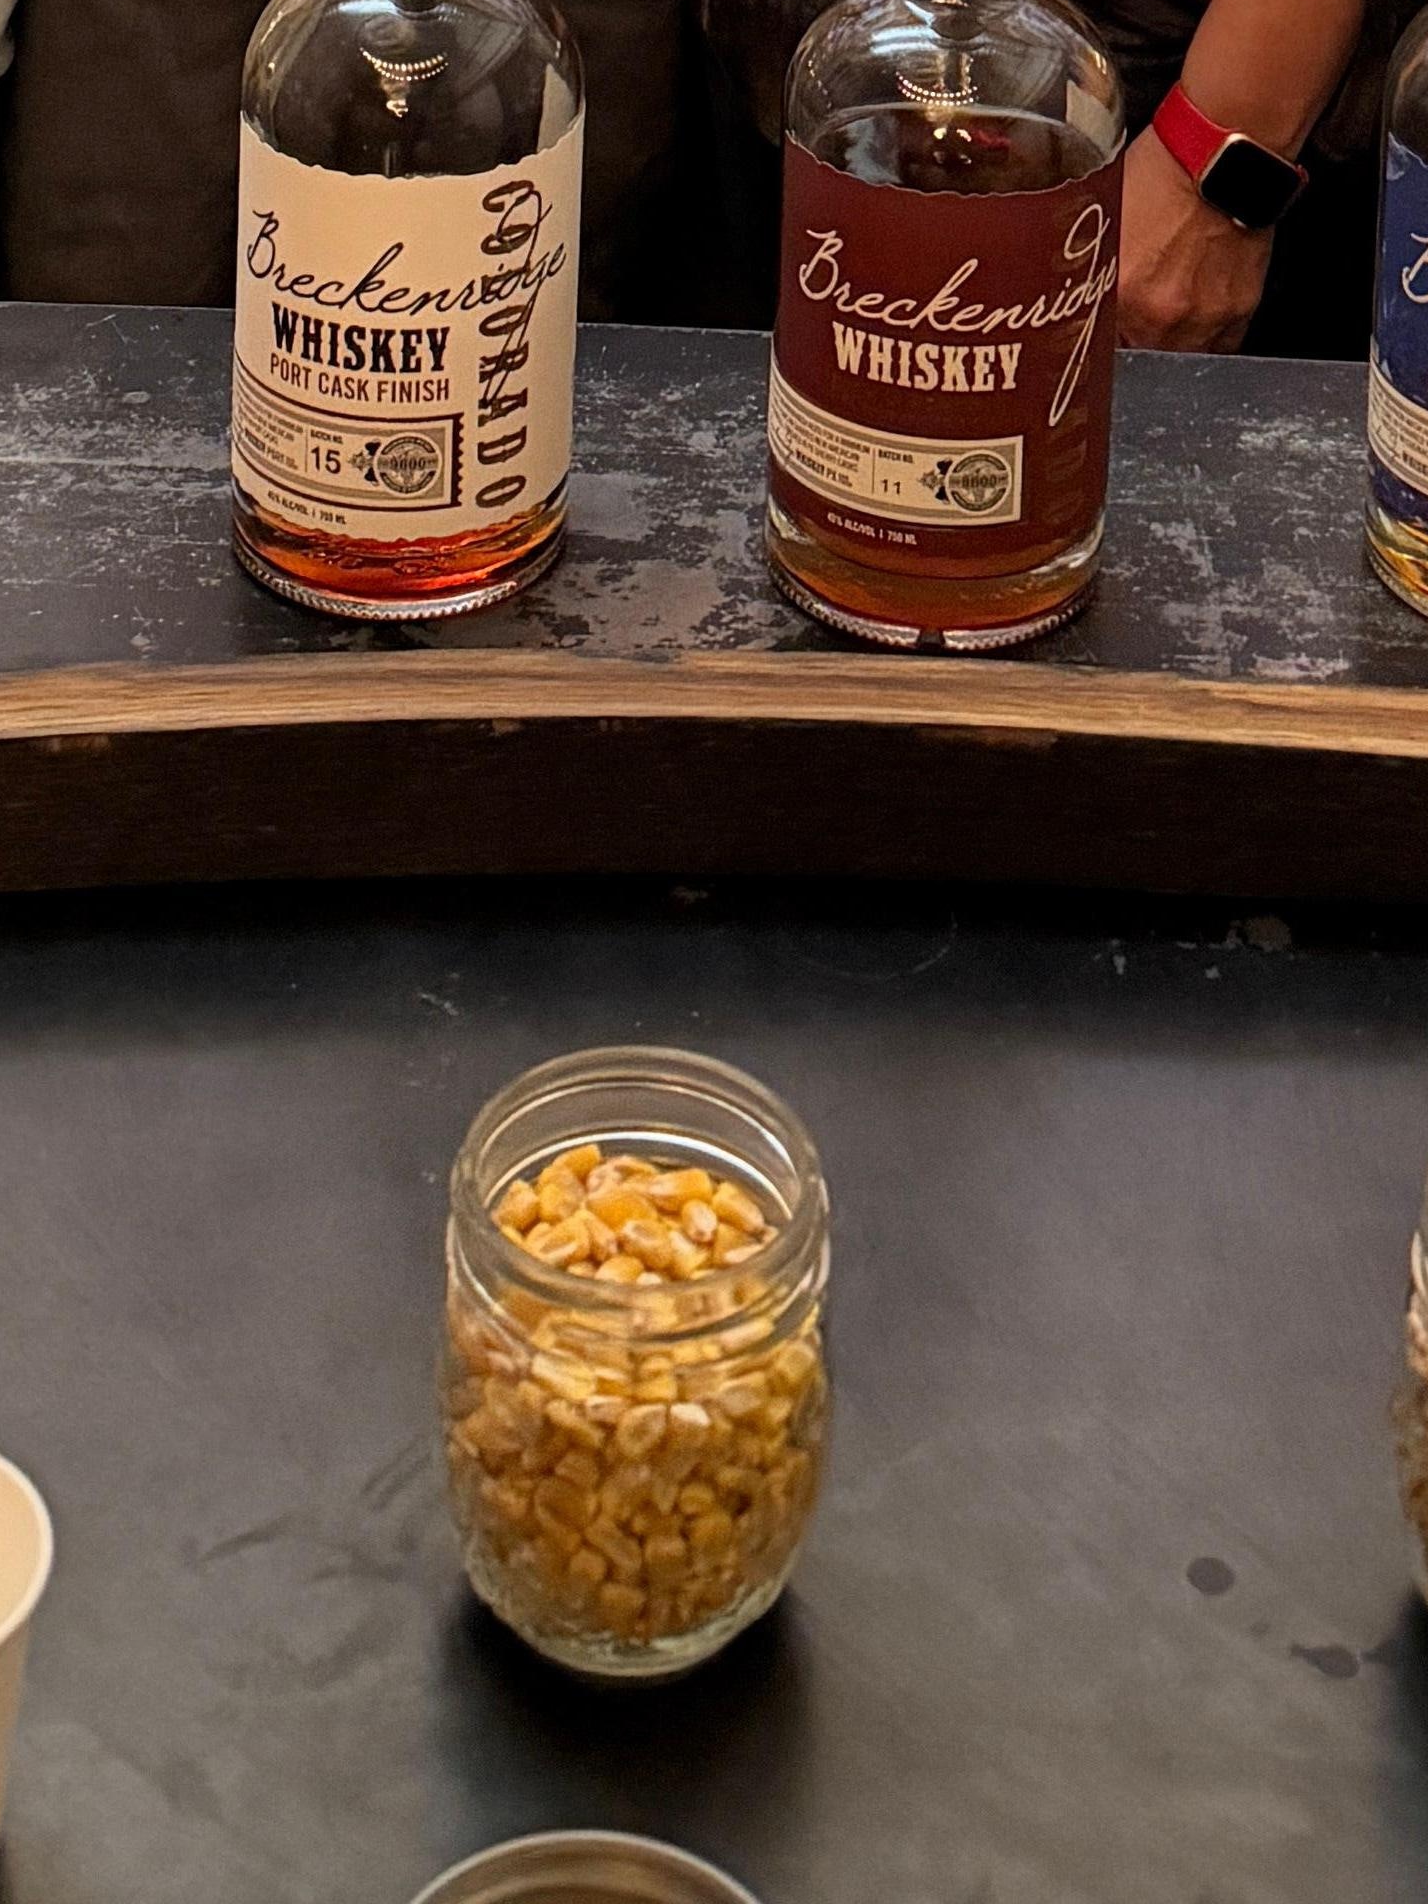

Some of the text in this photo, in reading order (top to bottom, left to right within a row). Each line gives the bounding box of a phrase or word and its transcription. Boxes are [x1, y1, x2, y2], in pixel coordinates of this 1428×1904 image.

[247, 190, 567, 407] Breckenridge
[799, 203, 1117, 427] Breckenridge
[271, 301, 451, 374] WHISKEY
[475, 179, 535, 509] COLORADO
[831, 320, 1022, 393] WHISKEY
[270, 355, 450, 405] PORT CASK FINISH
[311, 445, 341, 474] 15
[881, 478, 902, 495] 11
